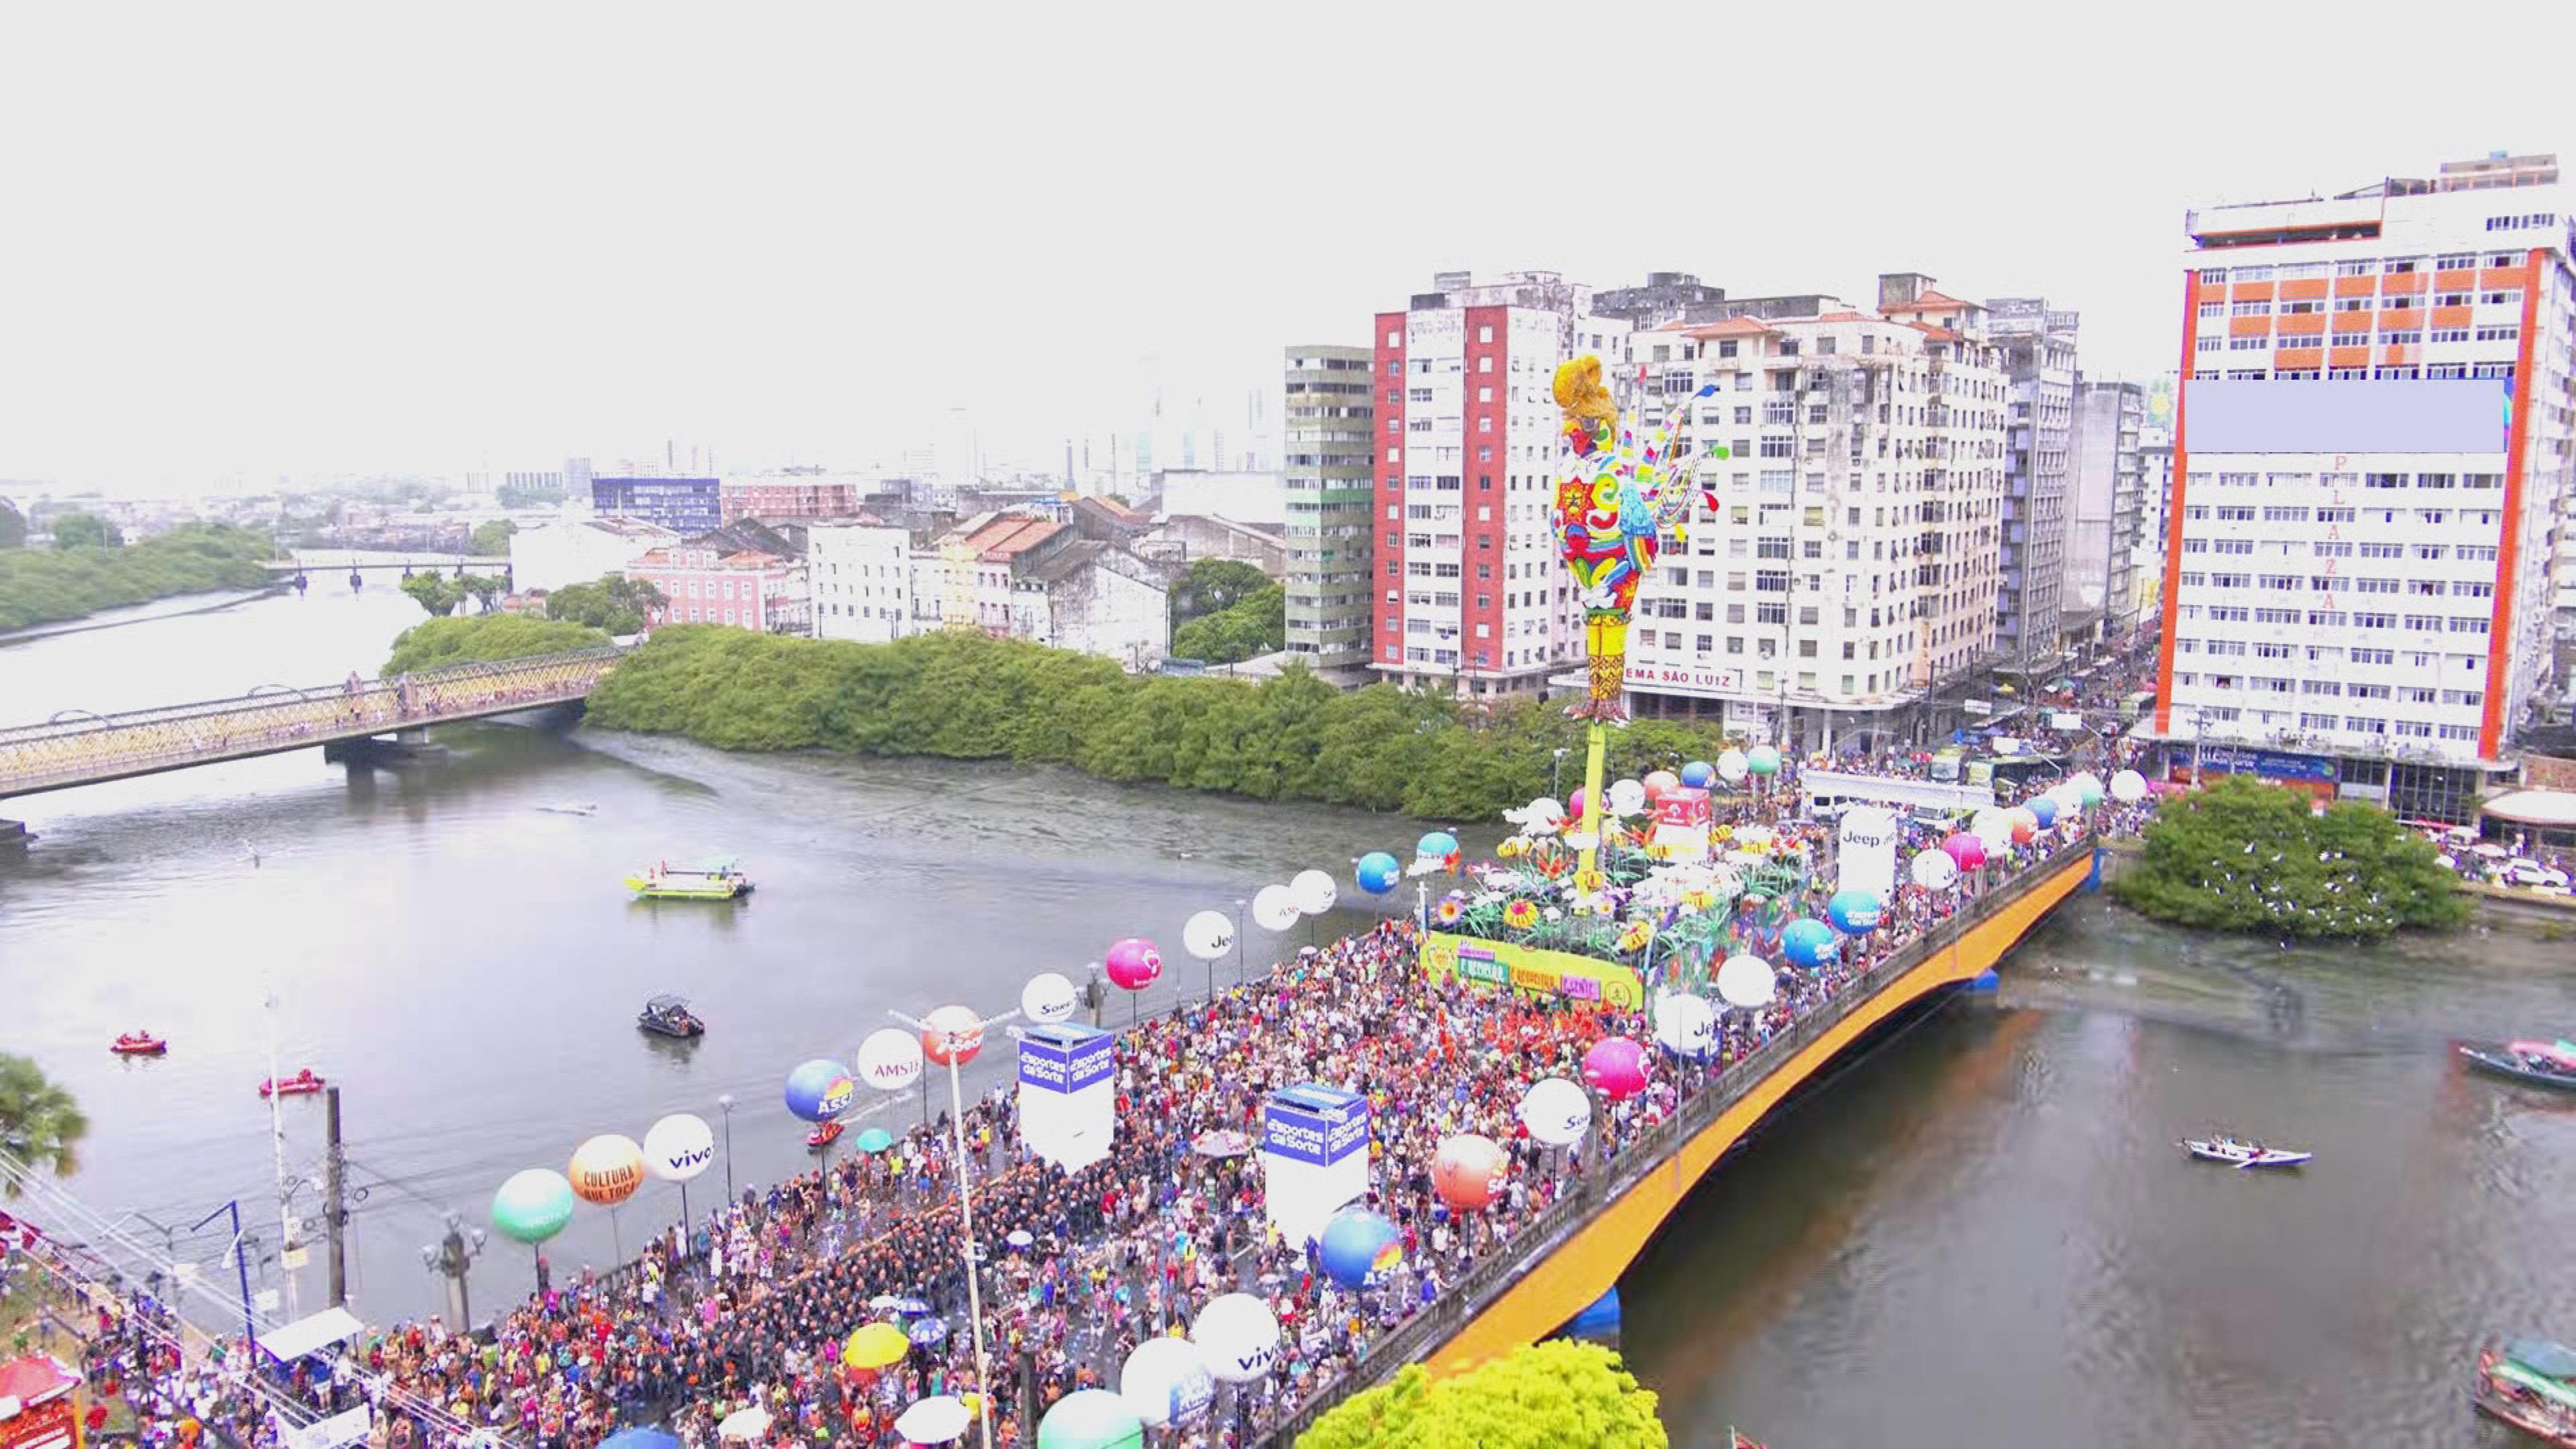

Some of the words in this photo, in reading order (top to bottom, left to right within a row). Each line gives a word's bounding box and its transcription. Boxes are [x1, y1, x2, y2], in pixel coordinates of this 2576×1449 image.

[1696, 674, 1731, 688] LUIZ
[1843, 830, 1880, 848] Jeep
[669, 1146, 712, 1169] vivo
[584, 1164, 635, 1188] CULTURA
